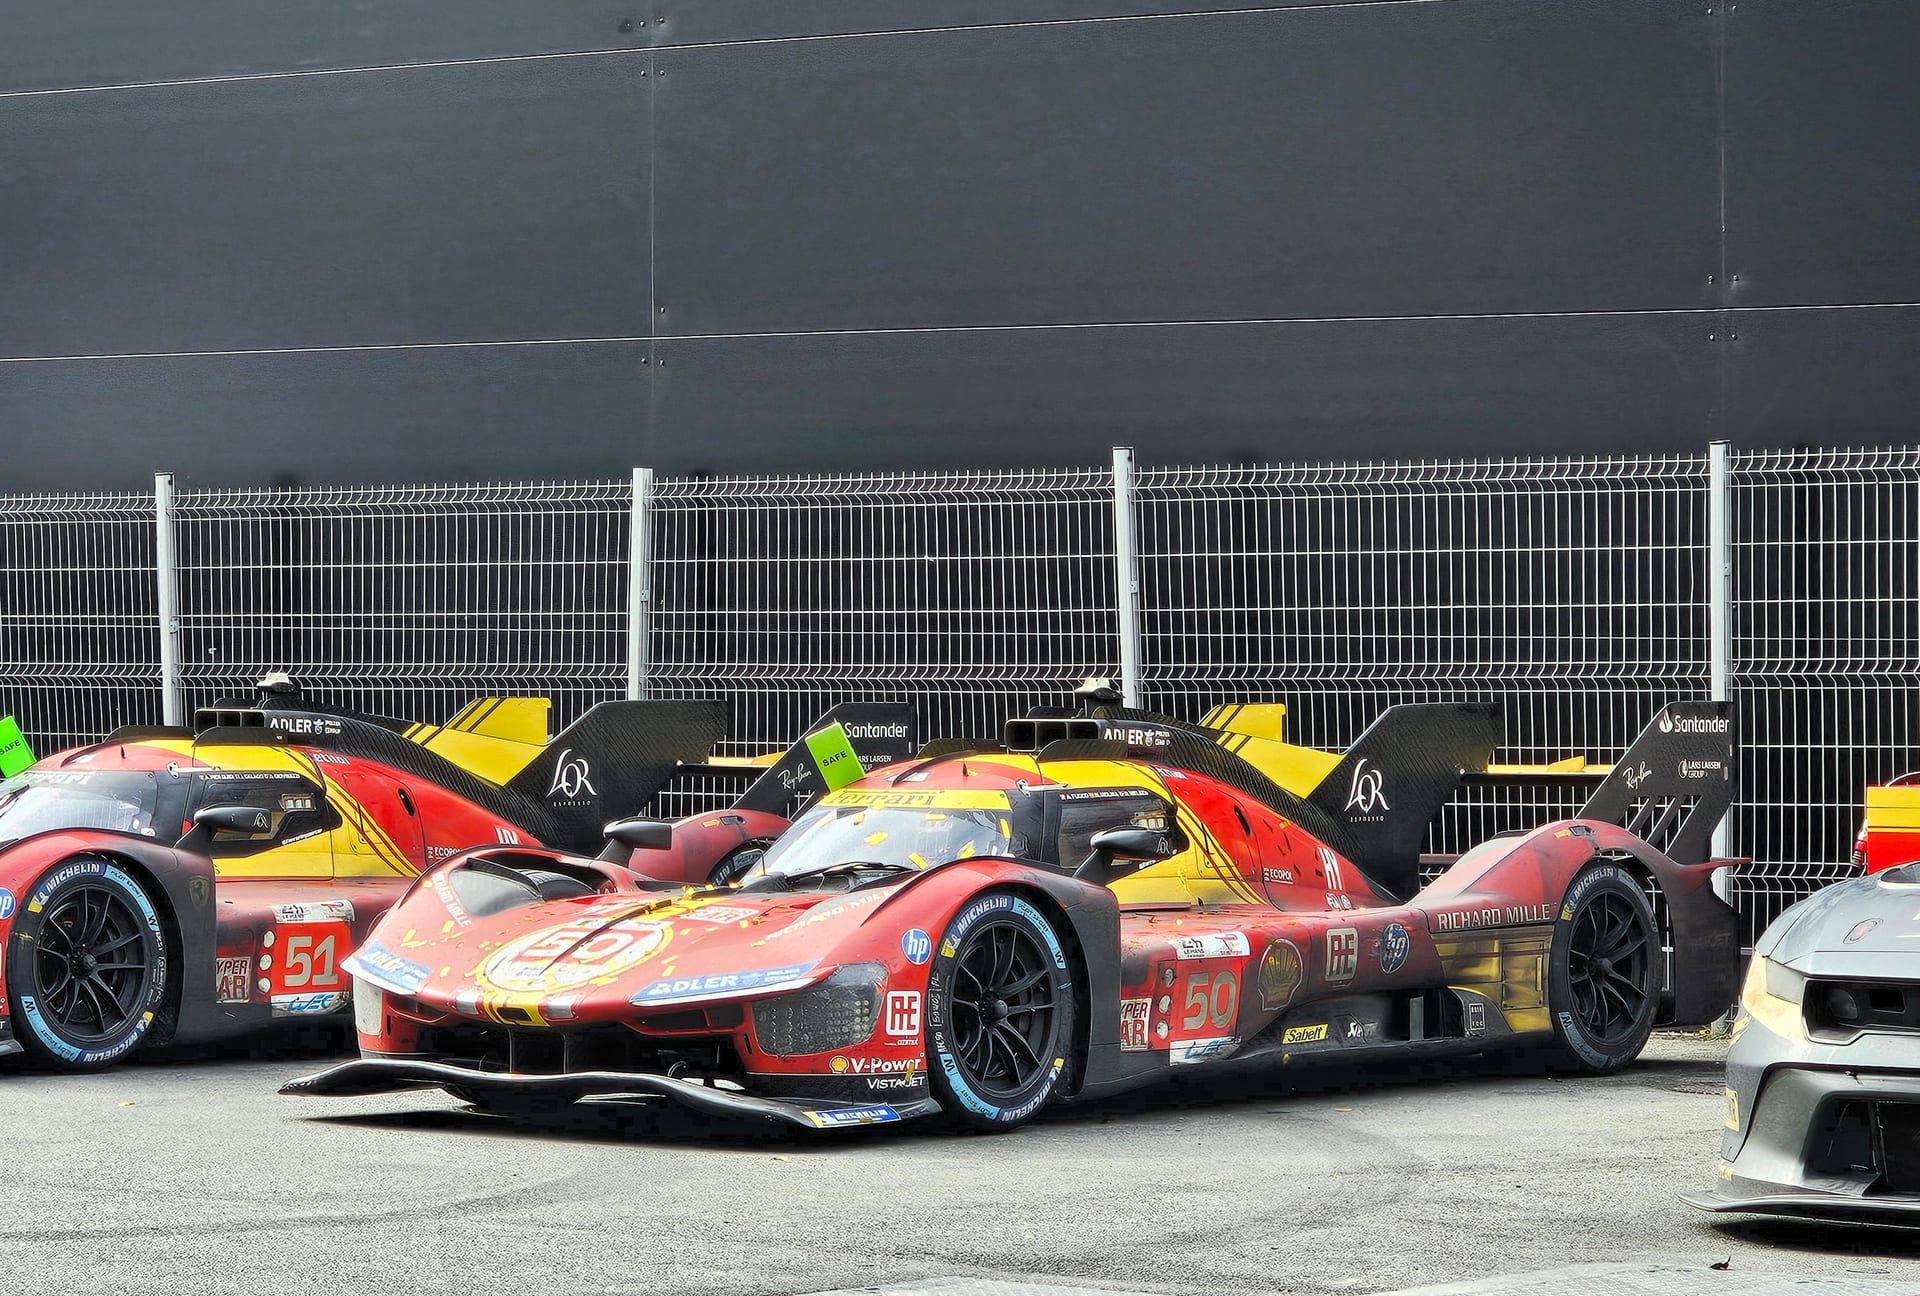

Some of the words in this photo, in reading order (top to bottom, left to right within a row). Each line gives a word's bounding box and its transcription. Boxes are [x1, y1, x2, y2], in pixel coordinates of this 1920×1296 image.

[270, 718, 312, 733] ADLER
[844, 722, 908, 738] Santander
[1674, 715, 1729, 733] Santander
[822, 750, 848, 767] SAFE
[46, 863, 101, 893] MICHELIN
[1270, 869, 1293, 881] ECOPOL
[1574, 867, 1615, 898] MICHELIN
[957, 897, 1008, 936] MICHELIN
[1437, 908, 1501, 930] RICHARD
[1506, 904, 1550, 924] MILLE
[908, 930, 928, 960] hp
[284, 935, 338, 987] 51
[647, 975, 740, 995] ADLER
[1183, 970, 1237, 1031] 50
[1287, 1027, 1323, 1043] Sabelt
[84, 1032, 138, 1063] MICHELIN
[851, 1059, 921, 1074] V-Power
[866, 1076, 925, 1089] VISTAJET
[1002, 1082, 1050, 1122] MICHELIN
[834, 1108, 888, 1121] MICHELIN
